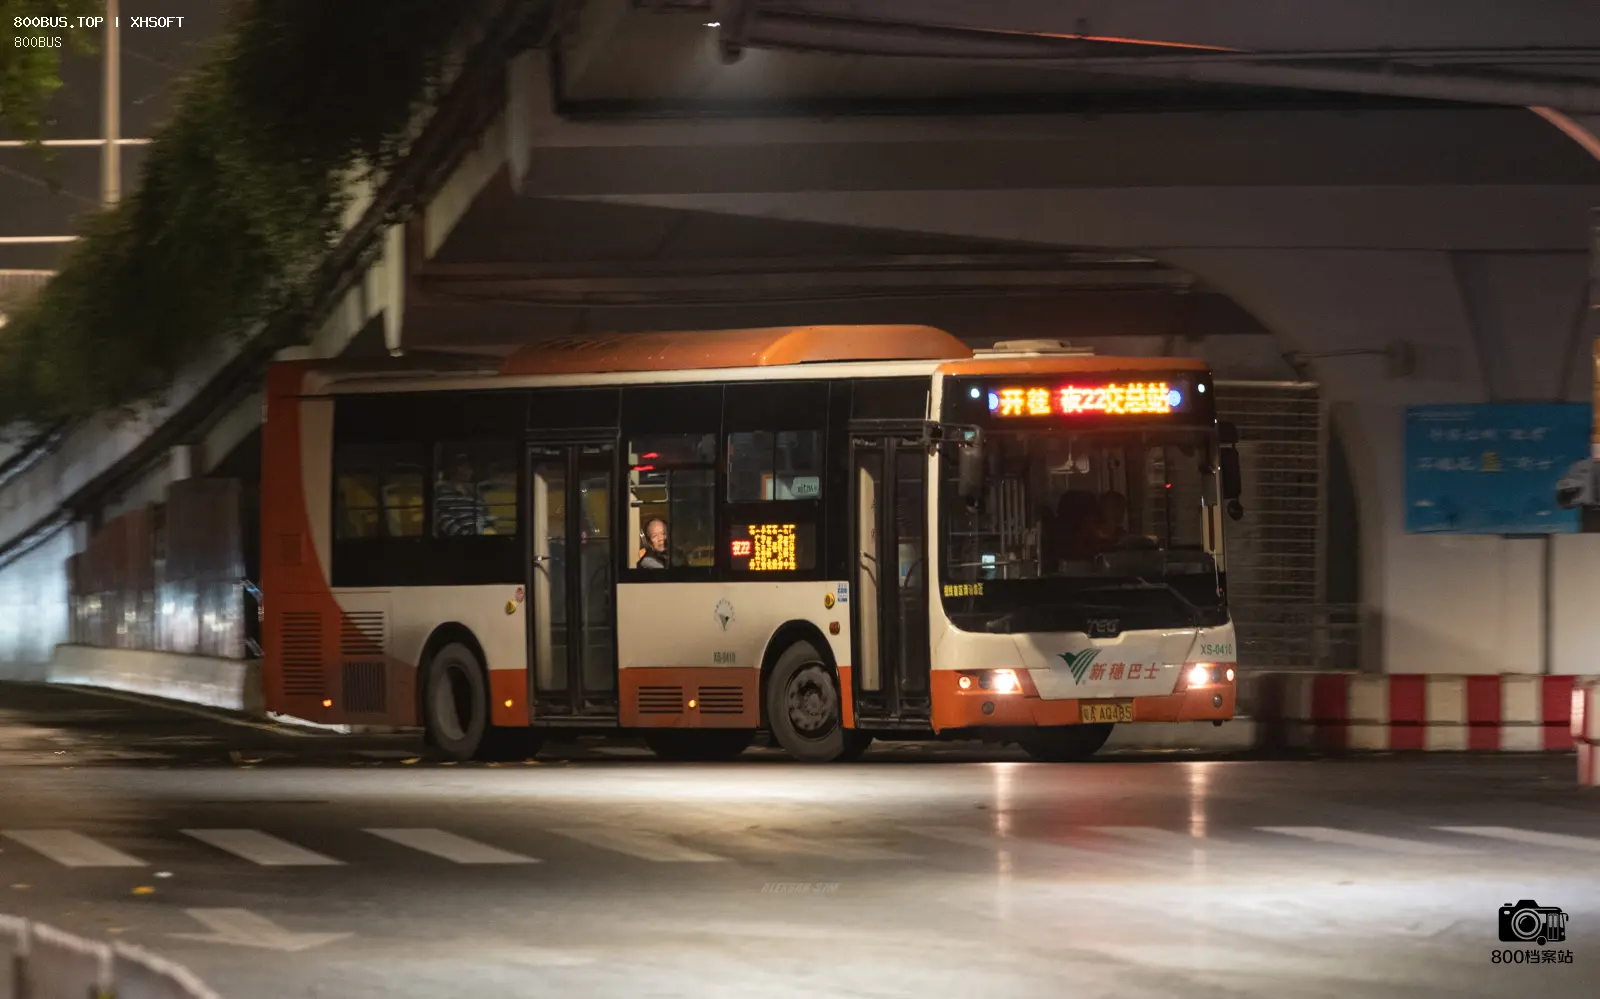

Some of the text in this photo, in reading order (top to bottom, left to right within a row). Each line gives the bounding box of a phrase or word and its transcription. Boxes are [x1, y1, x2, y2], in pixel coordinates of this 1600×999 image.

[1200, 643, 1232, 655] XS-0410
[1088, 662, 1160, 681] 新穗巴士
